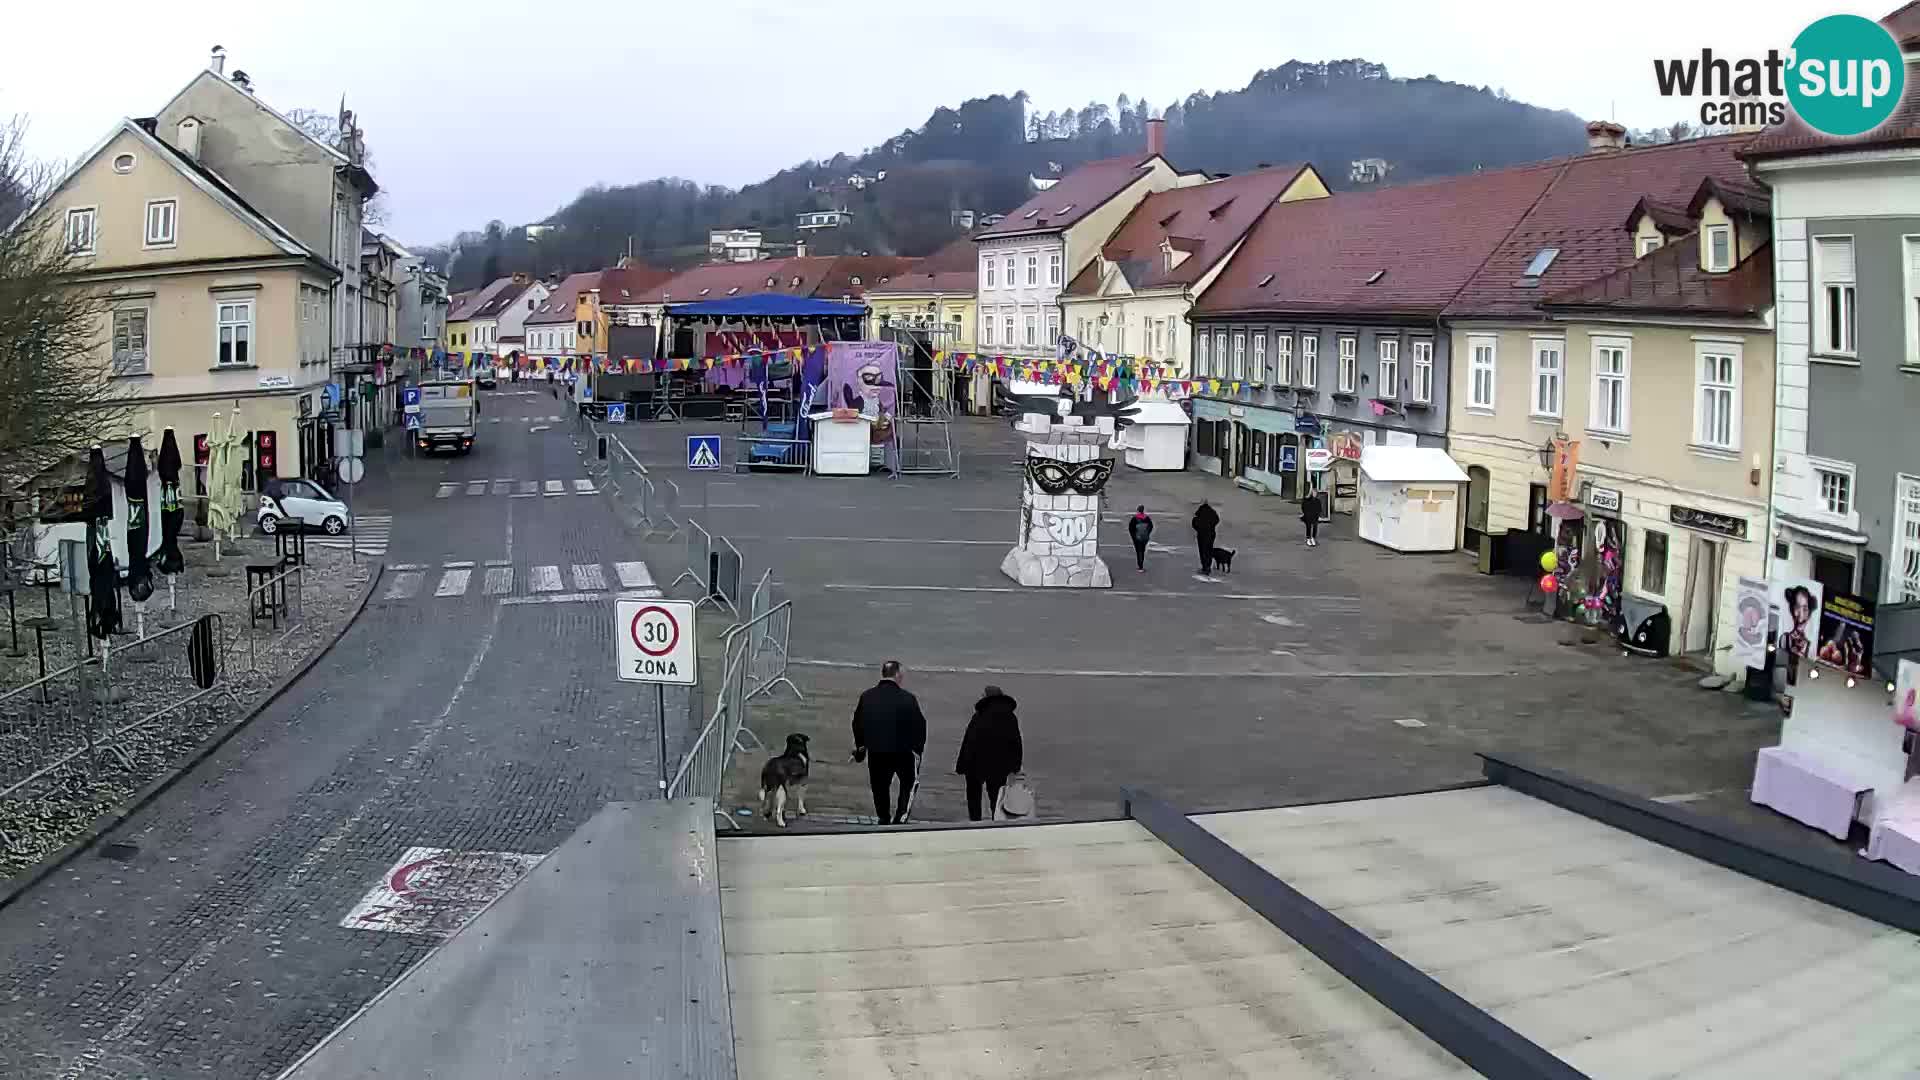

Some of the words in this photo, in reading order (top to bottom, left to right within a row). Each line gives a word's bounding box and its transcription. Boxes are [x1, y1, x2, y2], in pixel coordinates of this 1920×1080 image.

[407, 391, 416, 402] P
[1049, 516, 1087, 545] 200
[644, 622, 668, 643] 30
[634, 659, 678, 676] ZONA
